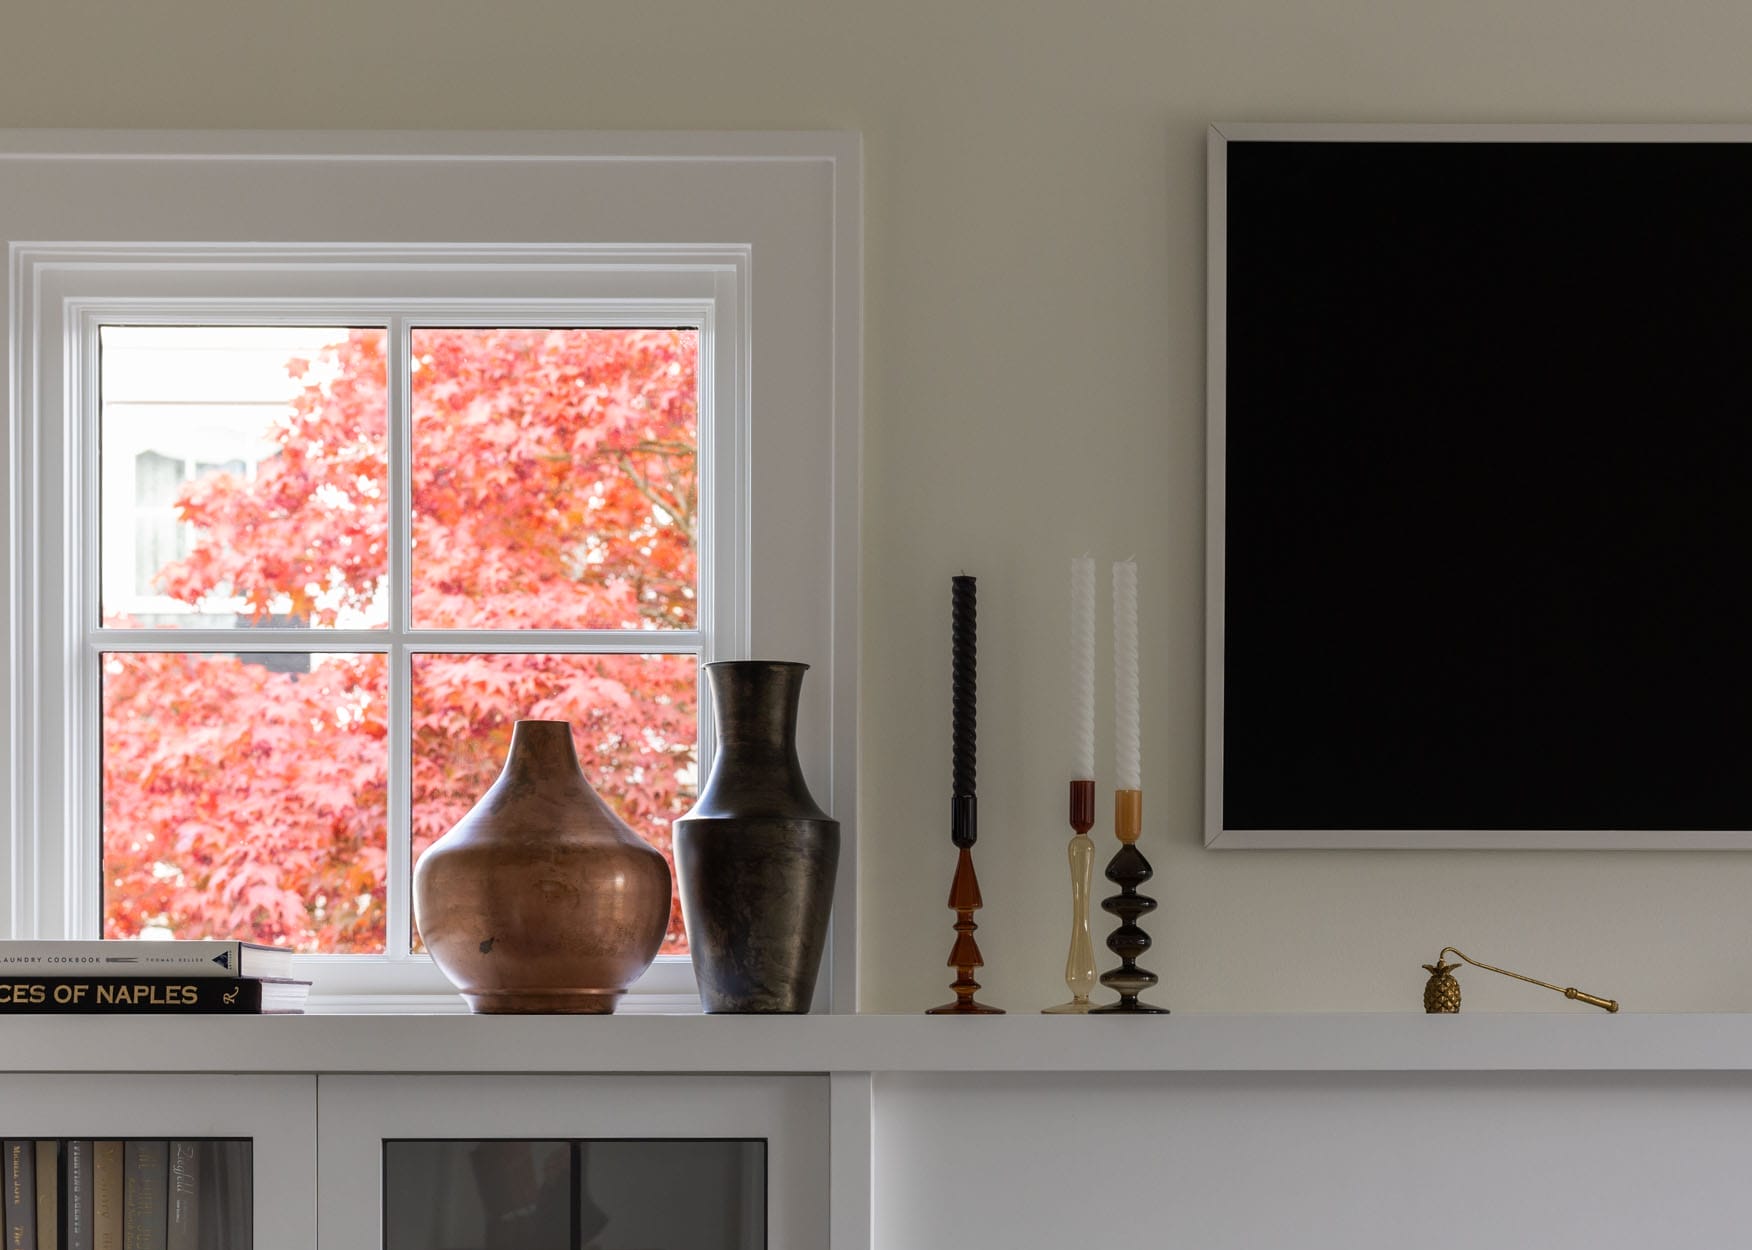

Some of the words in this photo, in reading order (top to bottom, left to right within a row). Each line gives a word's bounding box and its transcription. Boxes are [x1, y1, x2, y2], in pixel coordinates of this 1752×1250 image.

[53, 984, 89, 1004] OF
[96, 985, 199, 1005] NAPLES
[14, 1226, 25, 1245] The
